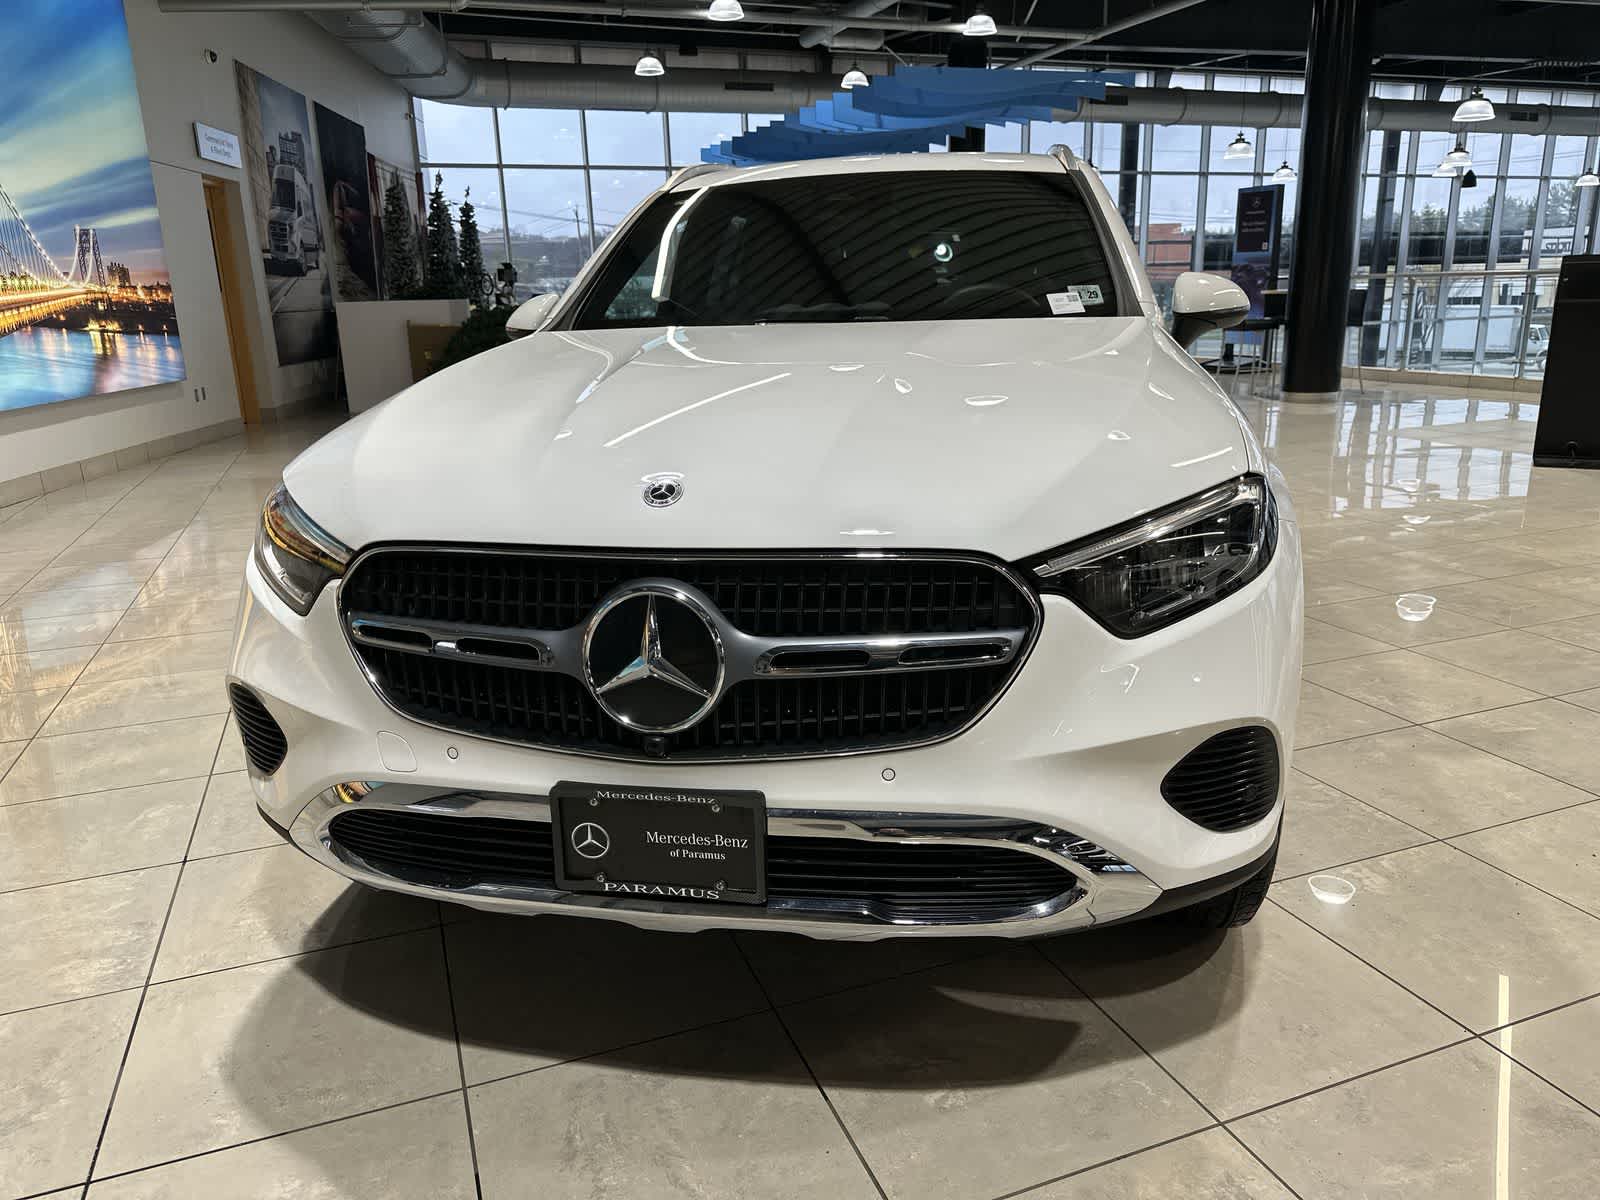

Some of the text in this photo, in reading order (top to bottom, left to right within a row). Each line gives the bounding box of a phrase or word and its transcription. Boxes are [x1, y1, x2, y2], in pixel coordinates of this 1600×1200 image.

[1087, 290, 1098, 299] 29
[597, 790, 715, 804] Mercedes-Benz
[645, 831, 748, 848] Mercedes-Benz
[669, 848, 726, 860] of Paramus
[604, 882, 720, 900] PARAMUS
